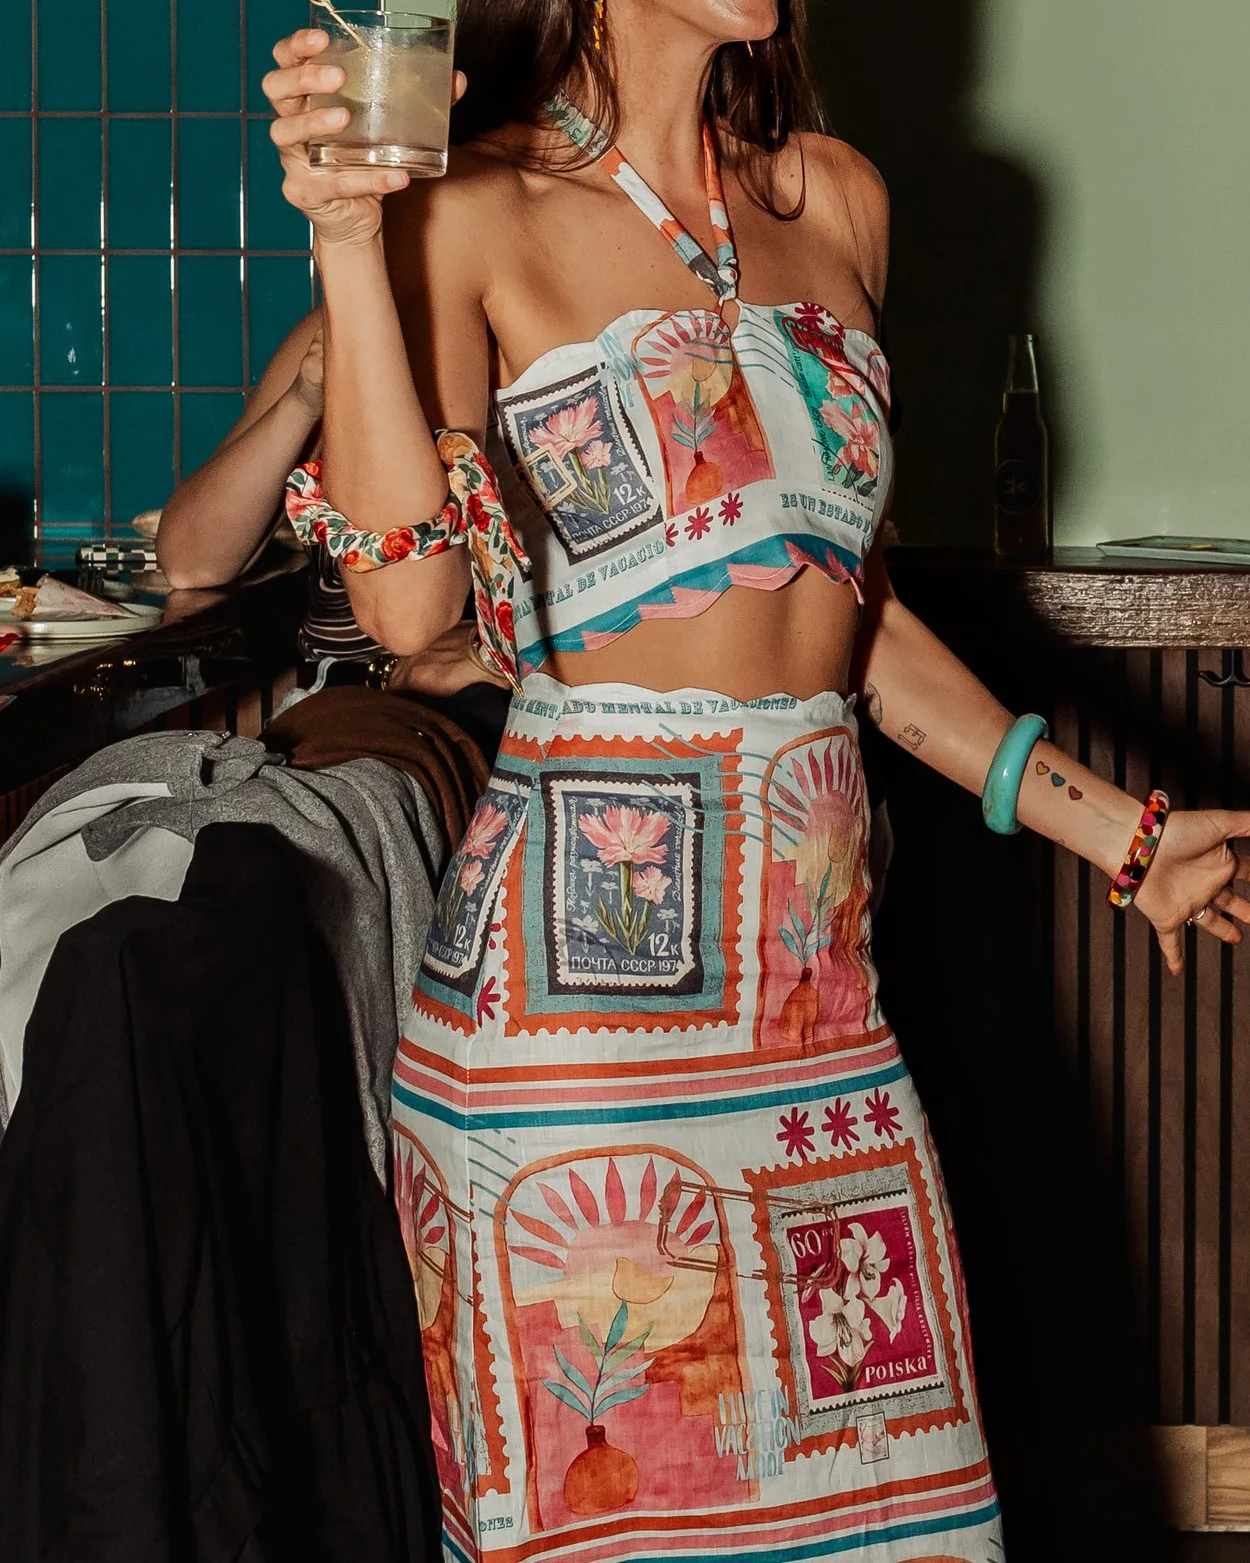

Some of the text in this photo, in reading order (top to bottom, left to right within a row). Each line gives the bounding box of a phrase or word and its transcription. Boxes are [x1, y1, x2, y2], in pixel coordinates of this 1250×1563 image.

[577, 570, 597, 594] DE
[598, 540, 668, 582] VACACIO
[601, 700, 677, 715] MENTAL
[680, 700, 704, 715] DE
[571, 956, 618, 971] ПОЧТА
[791, 1229, 822, 1259] 60
